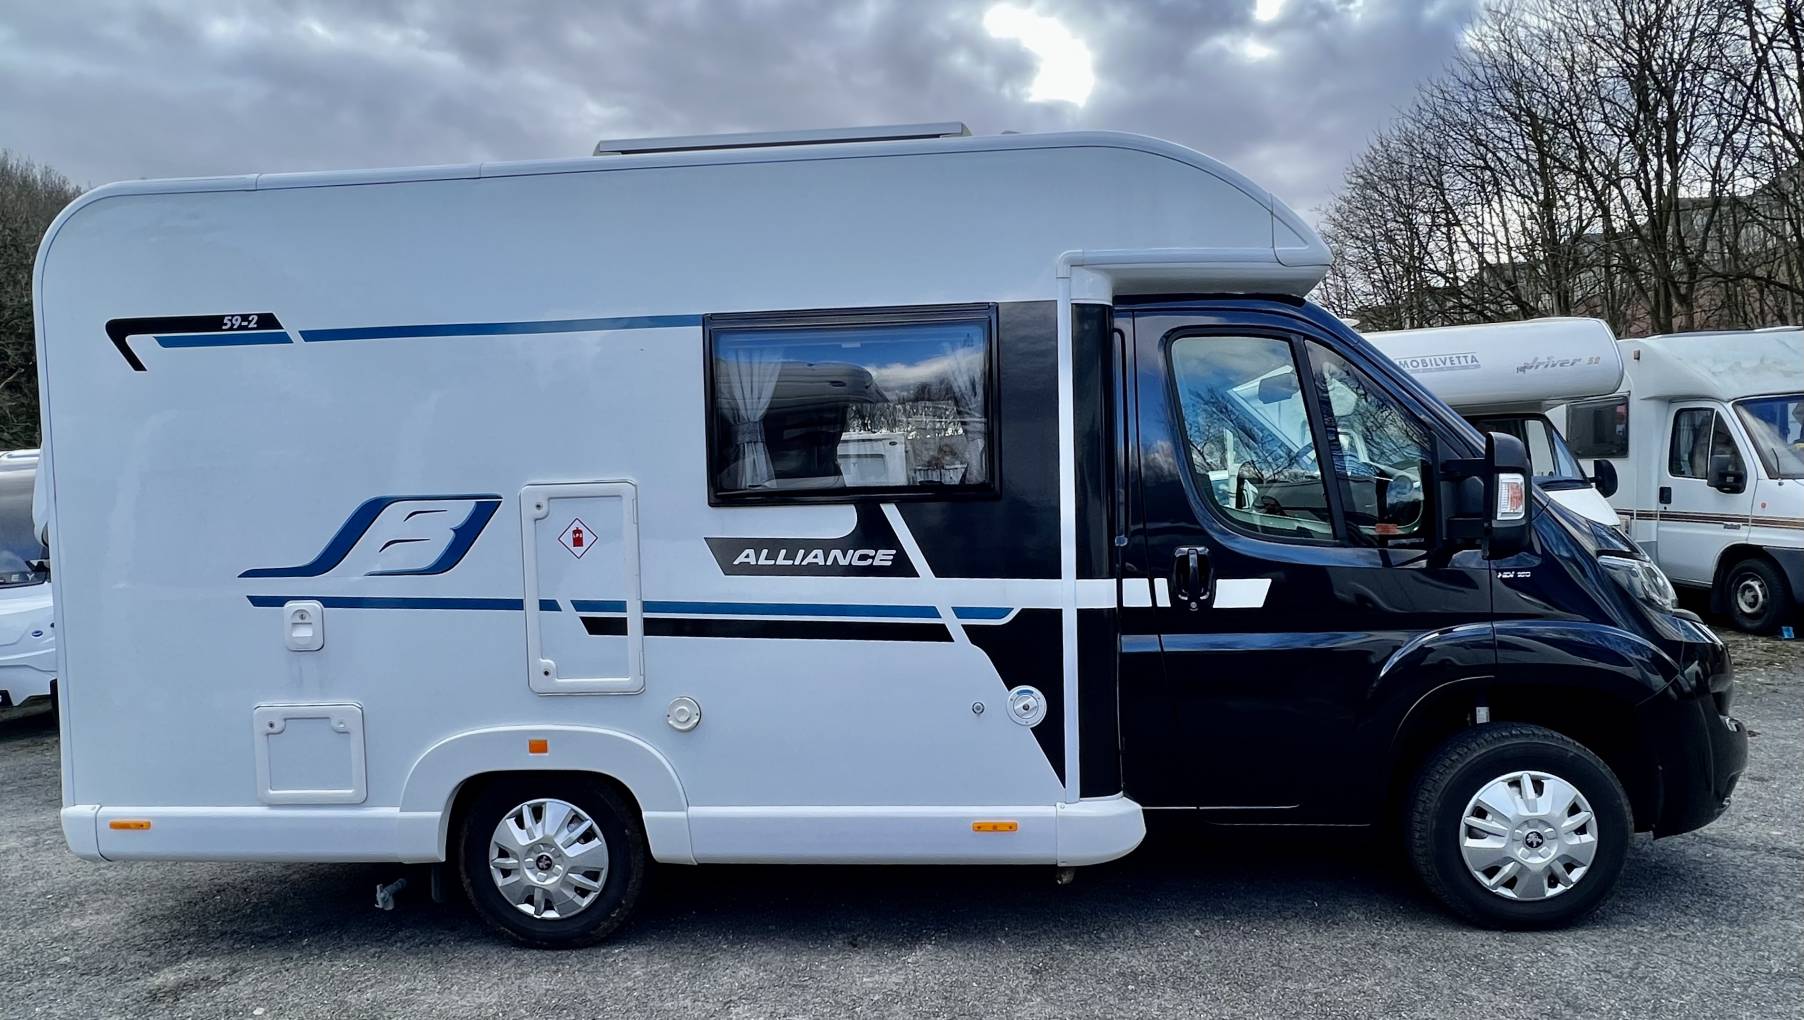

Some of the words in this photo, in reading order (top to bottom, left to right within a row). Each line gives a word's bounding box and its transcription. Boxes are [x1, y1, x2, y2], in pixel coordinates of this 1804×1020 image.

[222, 314, 258, 330] 59-2
[1399, 354, 1480, 369] MOBILVETTA
[732, 548, 897, 566] ALLIANCE
